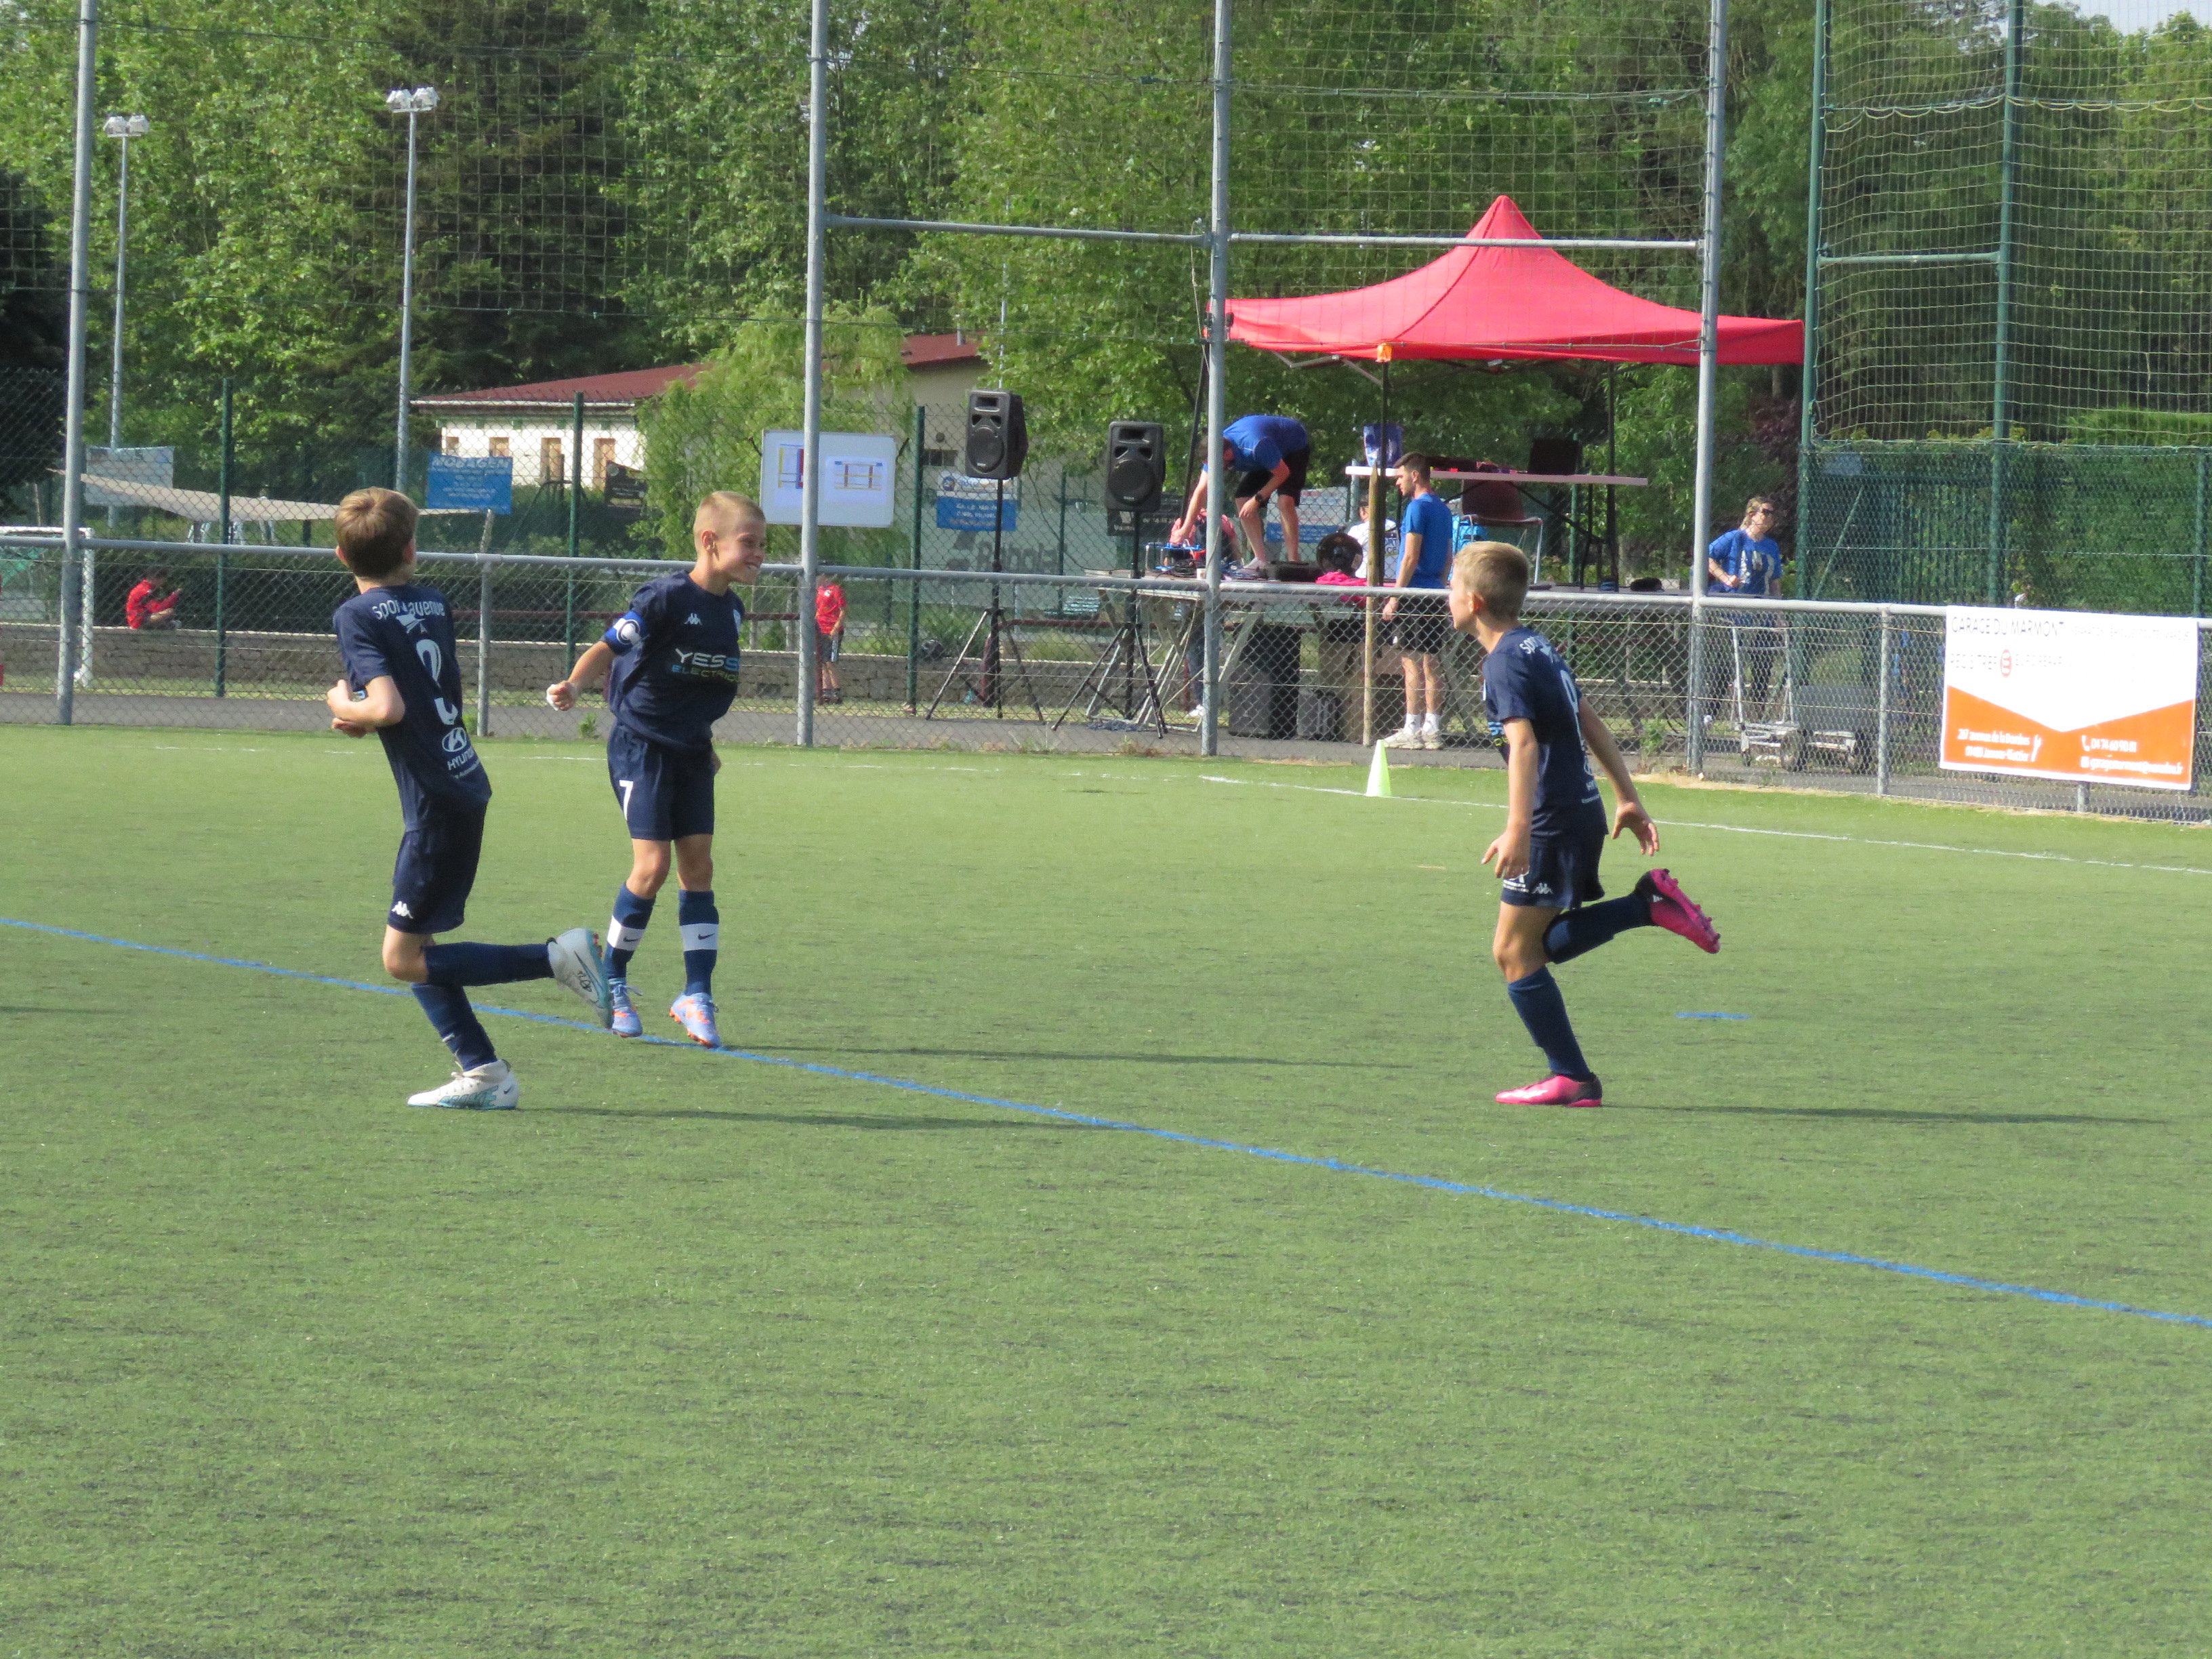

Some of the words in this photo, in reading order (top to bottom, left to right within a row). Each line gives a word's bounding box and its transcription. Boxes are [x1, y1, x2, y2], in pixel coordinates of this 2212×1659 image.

[1951, 616, 1990, 634] GARAGE
[1994, 618, 2007, 635] DU
[2011, 619, 2065, 637] MARMONT
[619, 779, 634, 821] 7
